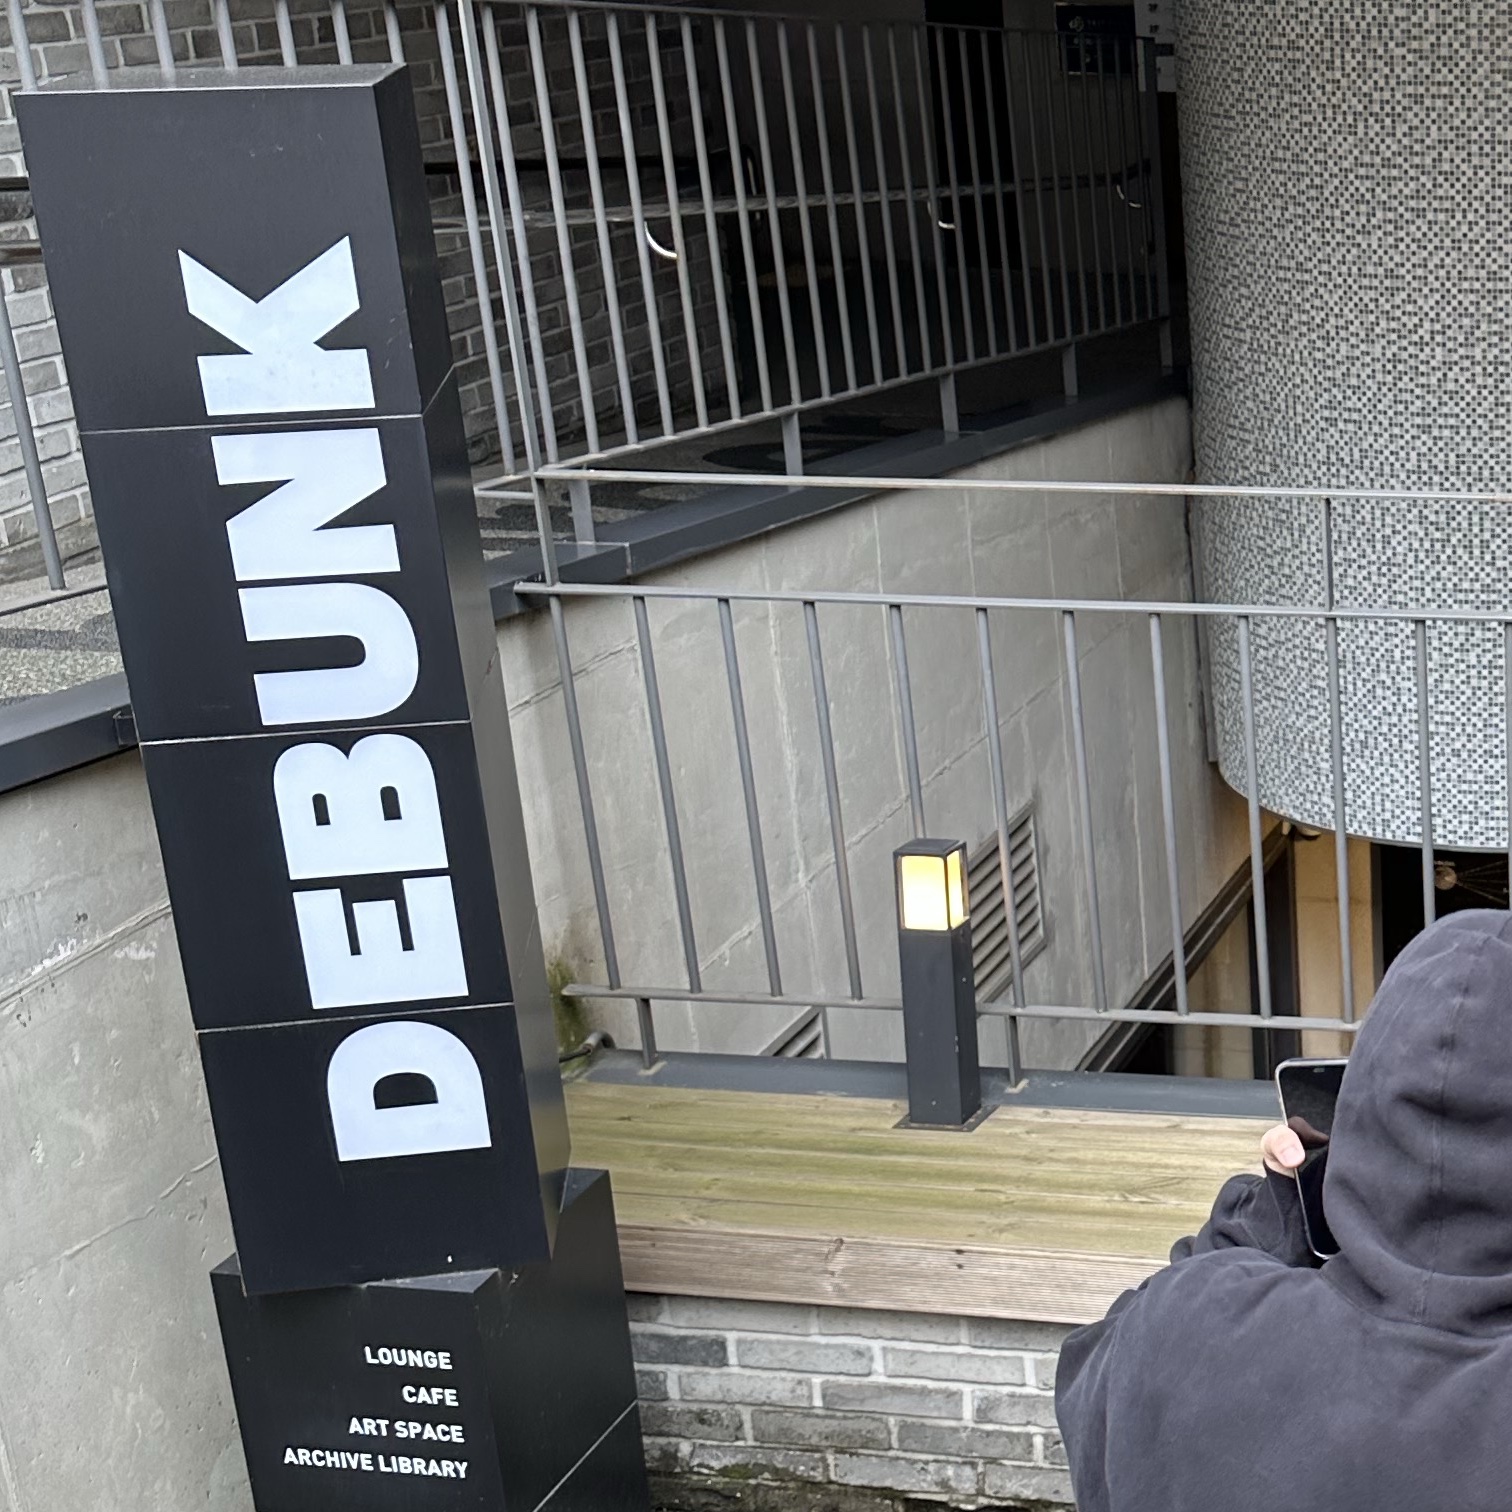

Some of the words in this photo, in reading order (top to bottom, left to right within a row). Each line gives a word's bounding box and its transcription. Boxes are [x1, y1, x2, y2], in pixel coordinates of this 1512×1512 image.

[177, 235, 493, 1163] DEBUNK
[364, 1346, 453, 1370] LOUNGE
[402, 1385, 459, 1407] CAFE
[348, 1416, 390, 1437] ART
[394, 1420, 465, 1443] SPACE
[283, 1447, 375, 1472] ARCHIVE
[377, 1454, 468, 1479] LIBRARY
